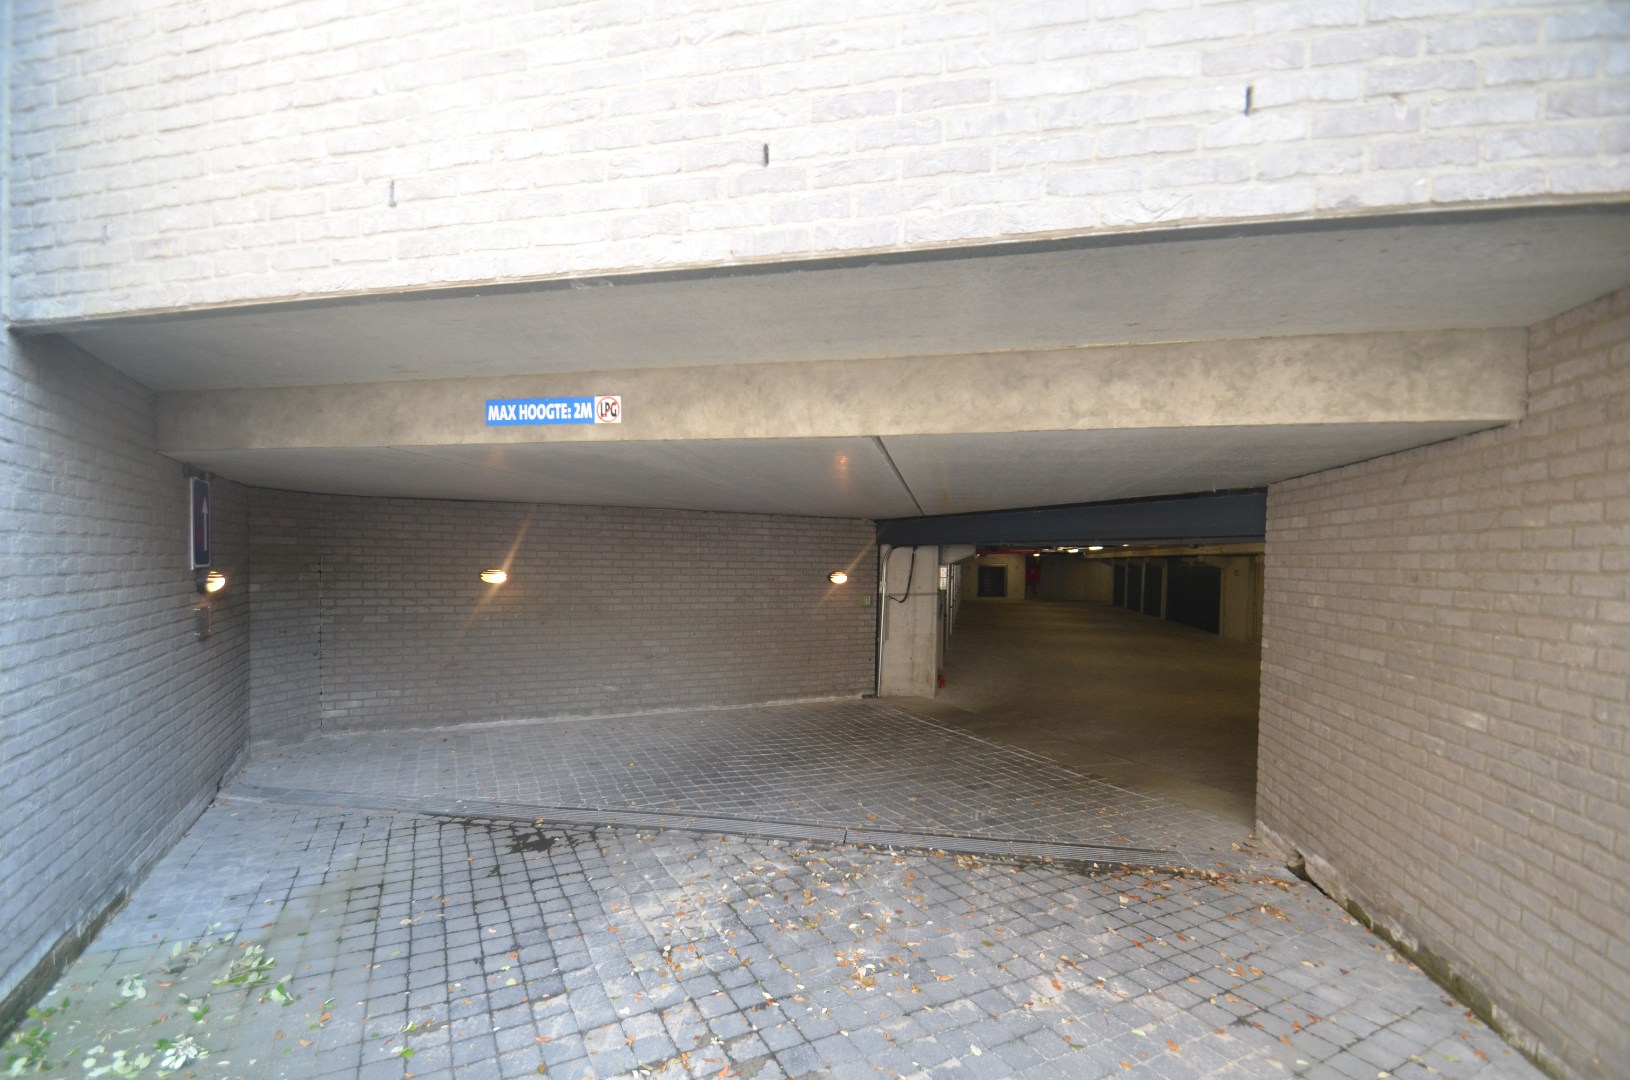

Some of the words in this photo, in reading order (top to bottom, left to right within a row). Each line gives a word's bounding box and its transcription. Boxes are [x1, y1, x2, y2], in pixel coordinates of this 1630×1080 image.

[488, 404, 516, 420] MAX
[519, 403, 571, 420] HOOGTE:
[573, 402, 593, 418] 2M
[600, 402, 617, 417] LPG
